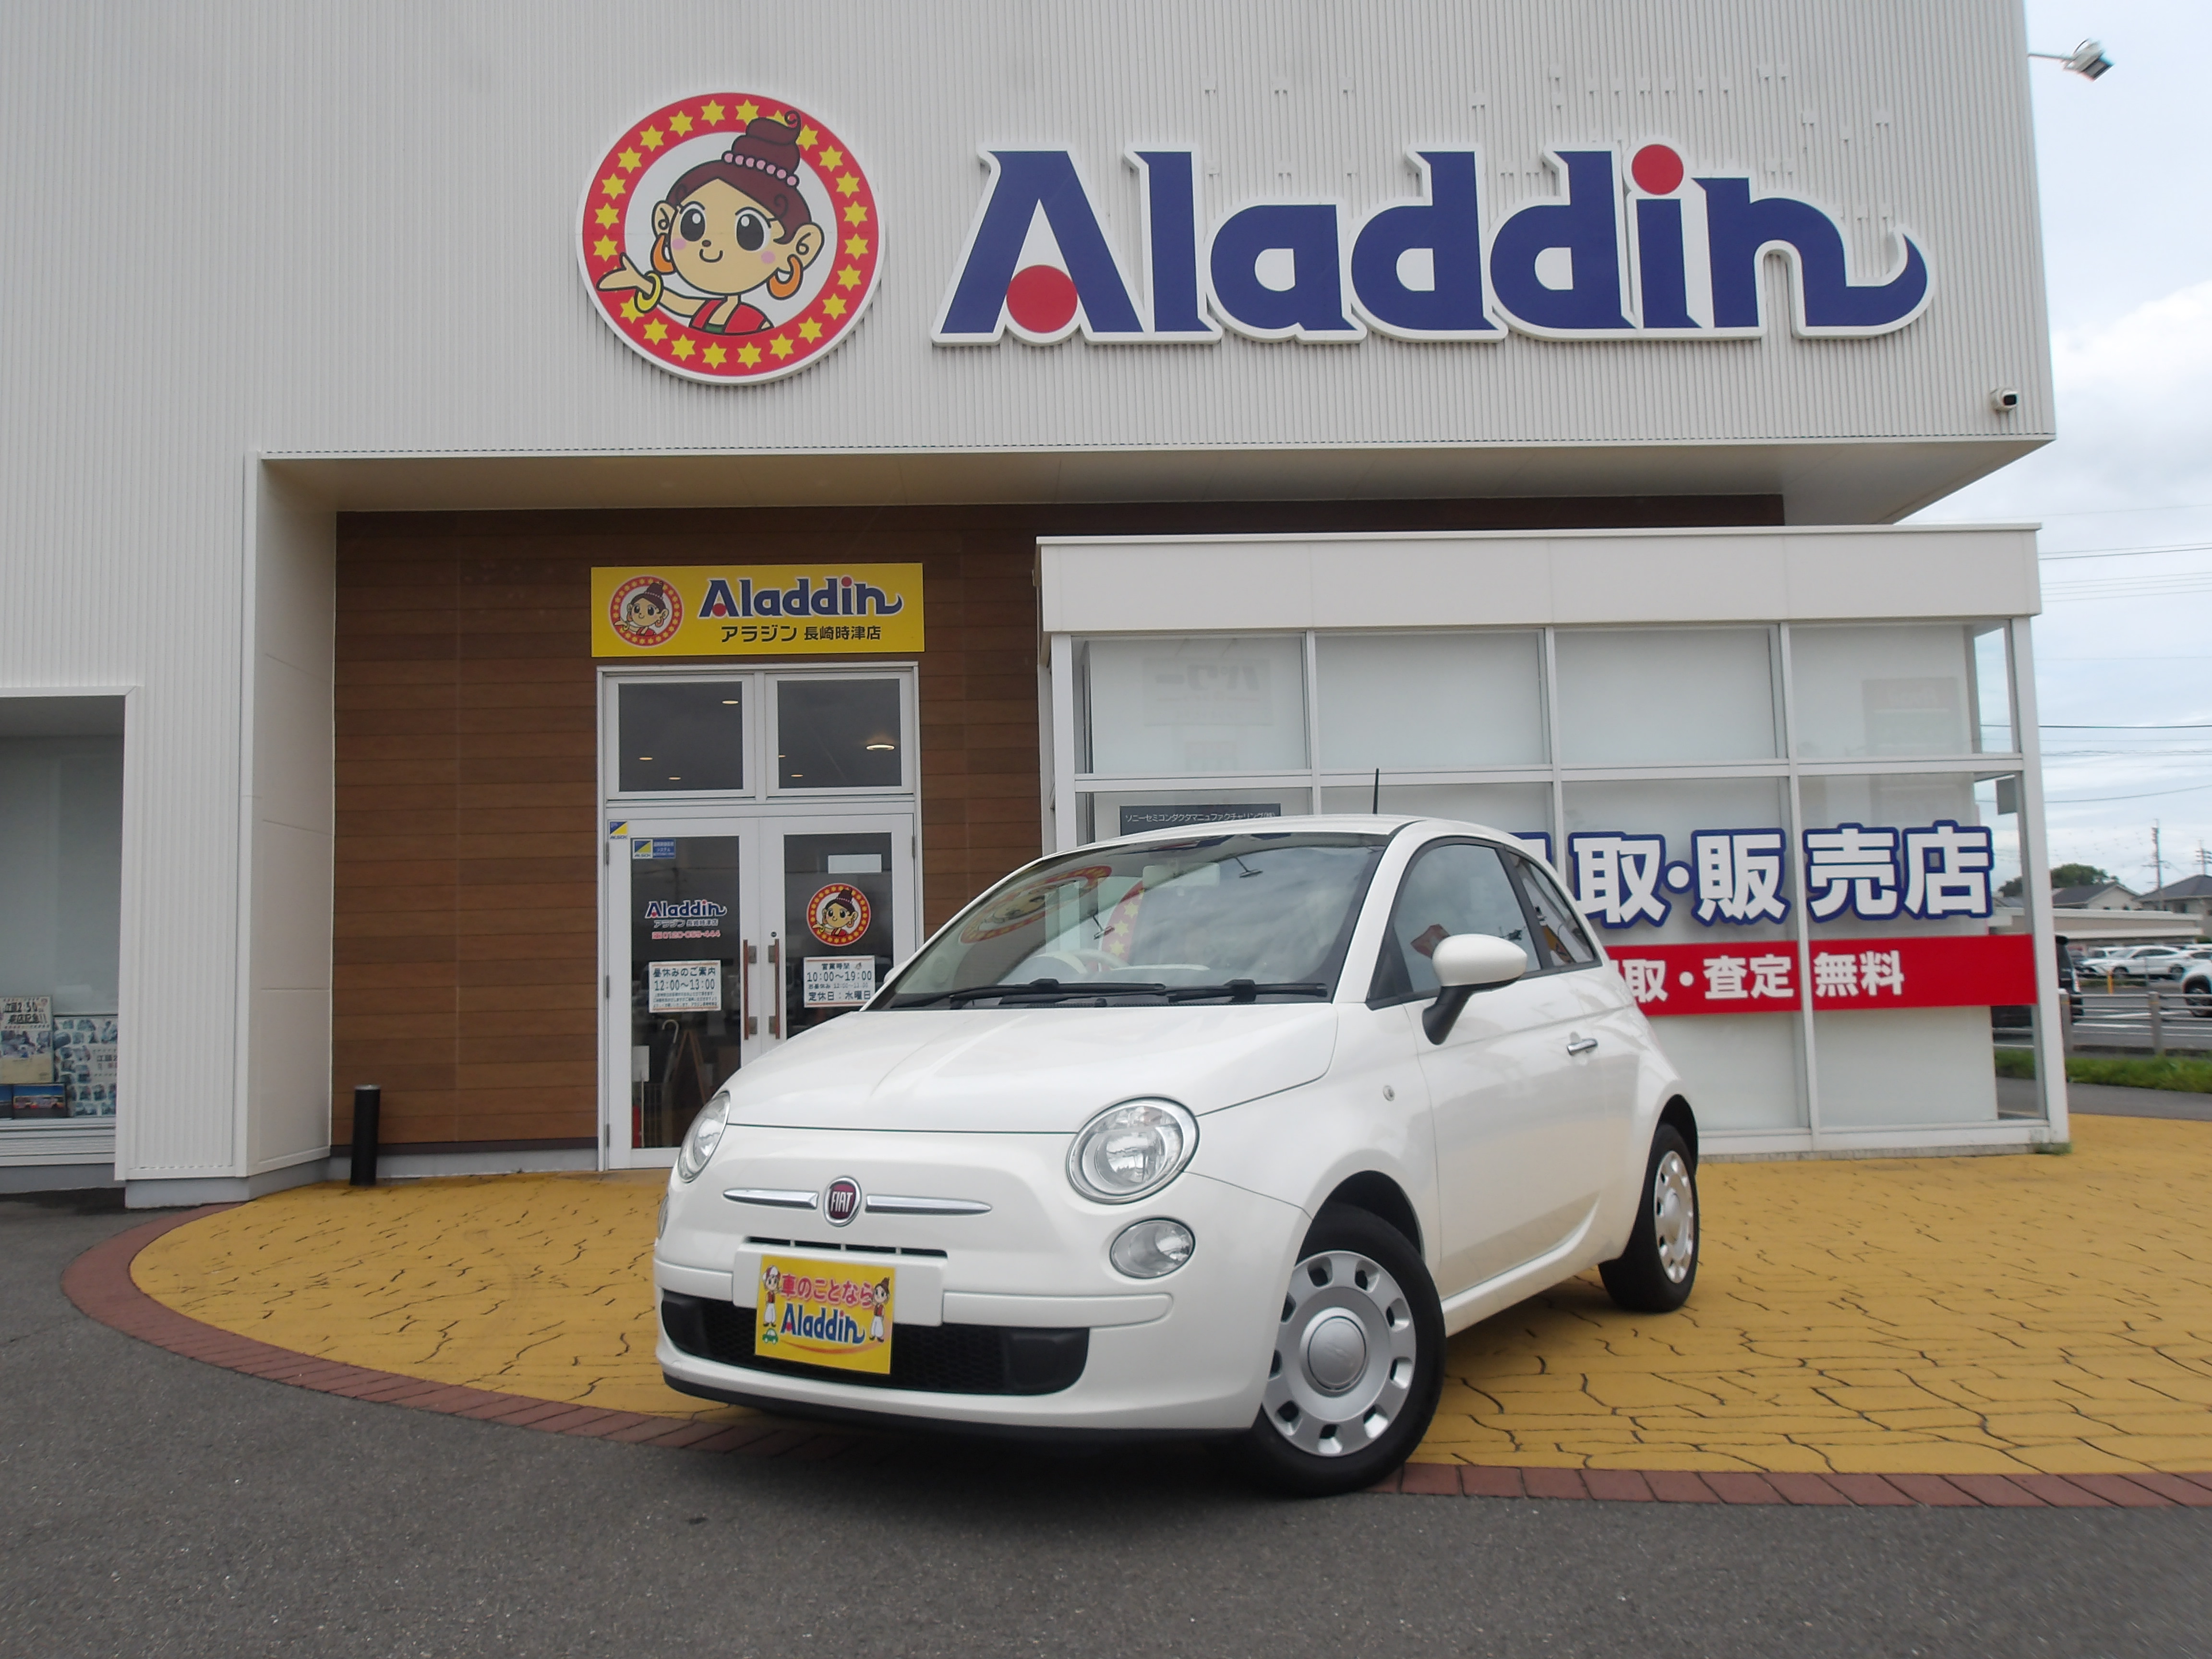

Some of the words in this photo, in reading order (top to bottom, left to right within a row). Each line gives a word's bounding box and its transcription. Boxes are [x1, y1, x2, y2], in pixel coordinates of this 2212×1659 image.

[934, 142, 1932, 340] Aladdin
[697, 576, 903, 619] Aladdin
[721, 625, 797, 643] アラジン
[804, 625, 881, 641] 長崎時津店
[1510, 820, 1992, 928] 取・販売店
[645, 899, 727, 918] Aladdin
[653, 967, 716, 977] 昼休みのご案内
[1609, 954, 1794, 1003] 取・査定
[1815, 950, 1903, 998] 無料
[830, 1190, 853, 1213] FIAT
[781, 1274, 874, 1309] 車のことなら
[780, 1301, 866, 1345] Aladdin
